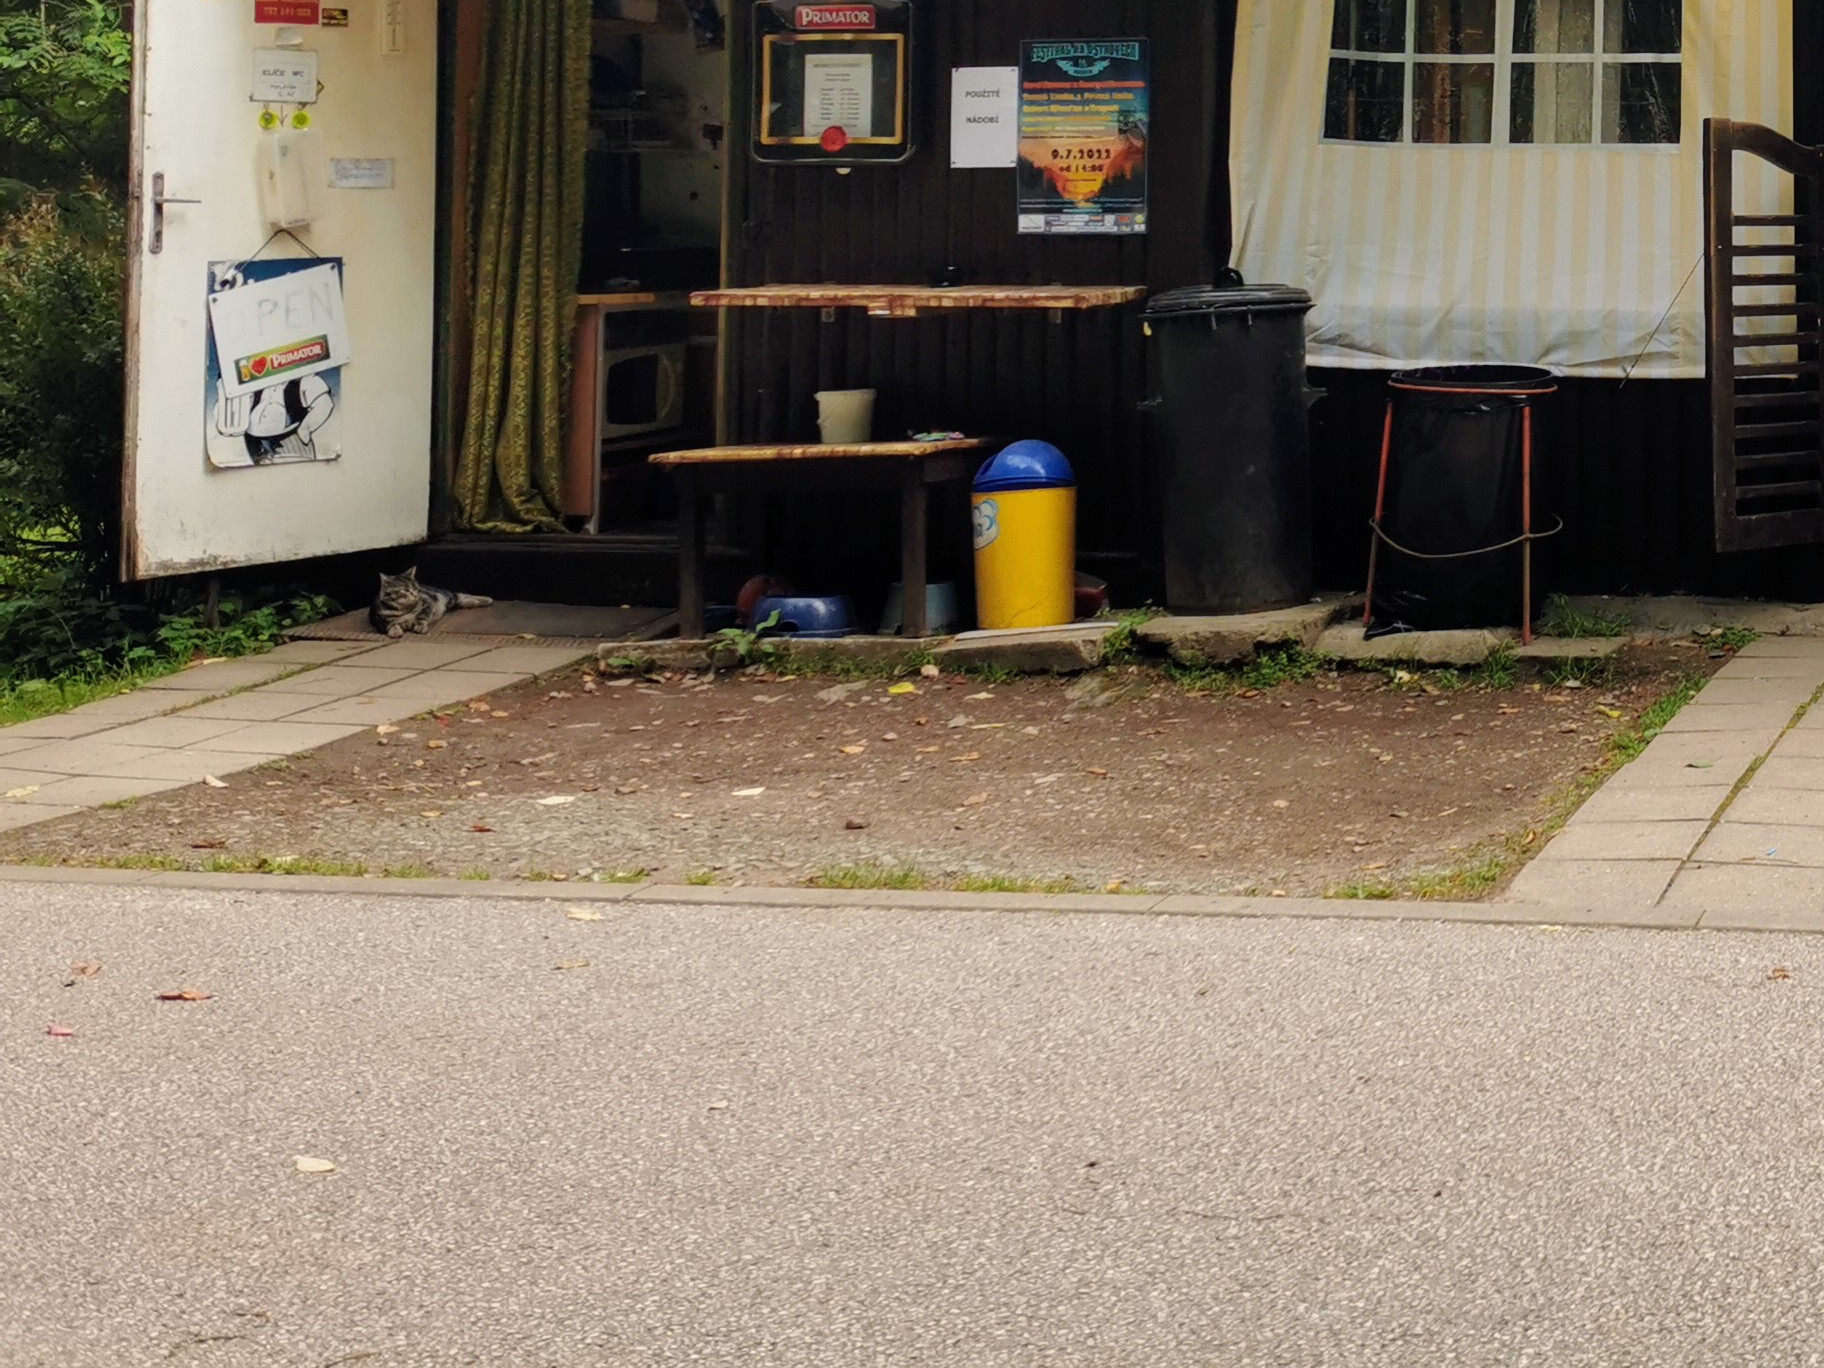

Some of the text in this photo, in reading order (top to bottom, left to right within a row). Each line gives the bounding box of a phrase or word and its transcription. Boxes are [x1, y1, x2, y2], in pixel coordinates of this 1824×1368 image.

[802, 7, 870, 26] PRIMATOR
[965, 113, 1000, 124] NÁDOBÍ
[1051, 147, 1112, 160] 9.7.2022
[272, 343, 323, 368] PRIMATOR
